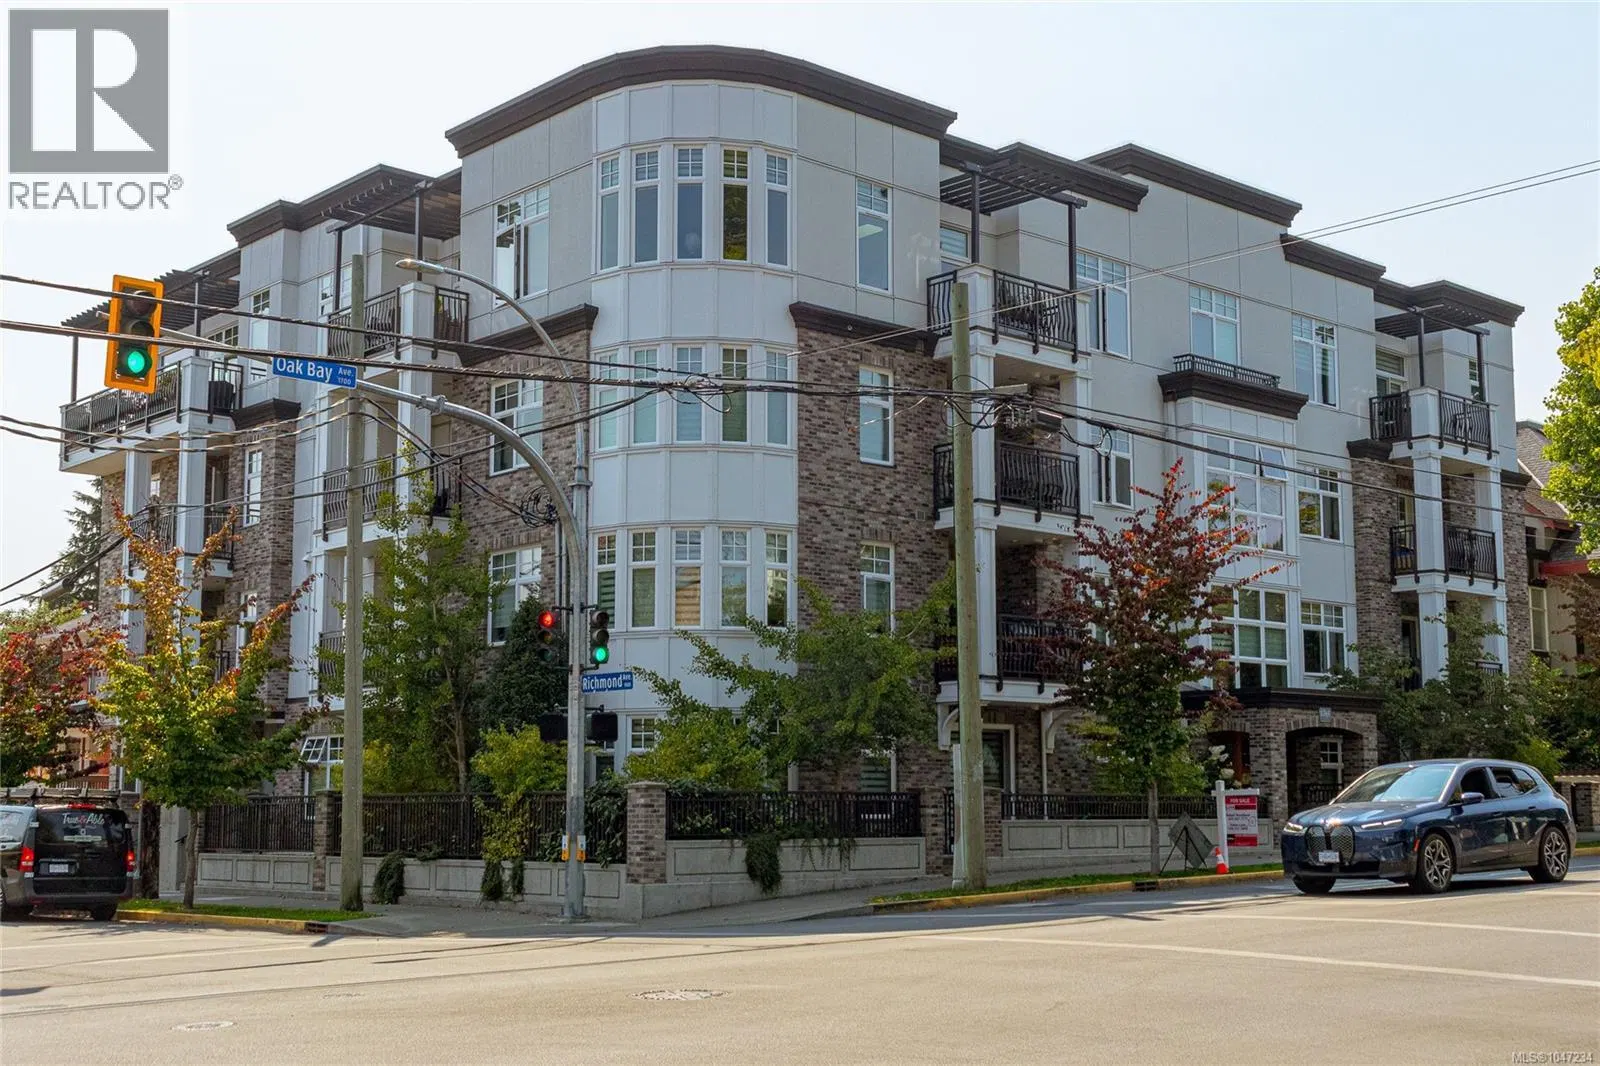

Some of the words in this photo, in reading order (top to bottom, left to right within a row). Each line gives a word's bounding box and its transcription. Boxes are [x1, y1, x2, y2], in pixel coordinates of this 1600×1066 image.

[276, 357, 304, 375] Oak
[307, 361, 333, 384] Bay
[582, 674, 623, 691] Richmond
